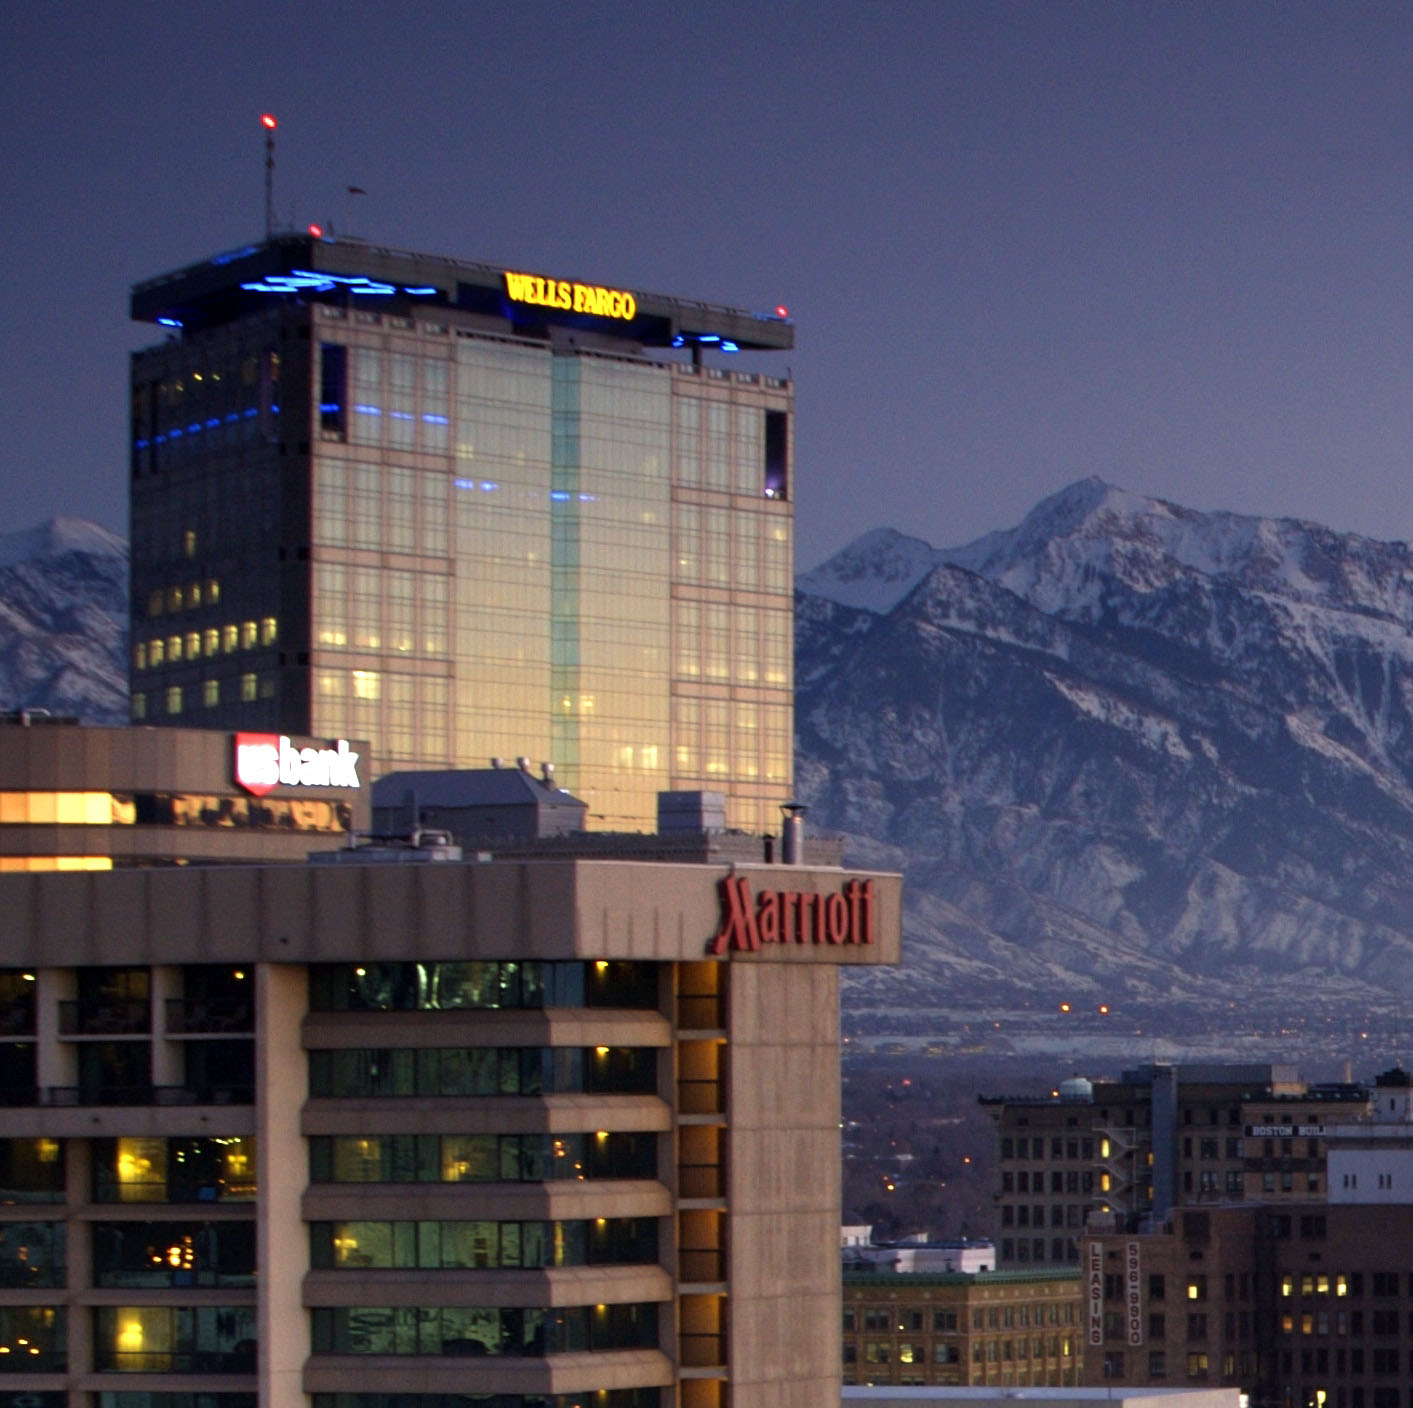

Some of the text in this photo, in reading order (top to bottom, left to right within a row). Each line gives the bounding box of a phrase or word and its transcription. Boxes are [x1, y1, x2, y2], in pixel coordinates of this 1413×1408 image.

[505, 271, 636, 320] WELLS FARGO
[715, 875, 876, 955] Marriott
[1252, 1126, 1293, 1137] BOSTON
[1090, 1243, 1102, 1344] LEASING
[1128, 1243, 1141, 1344] 596-9900
